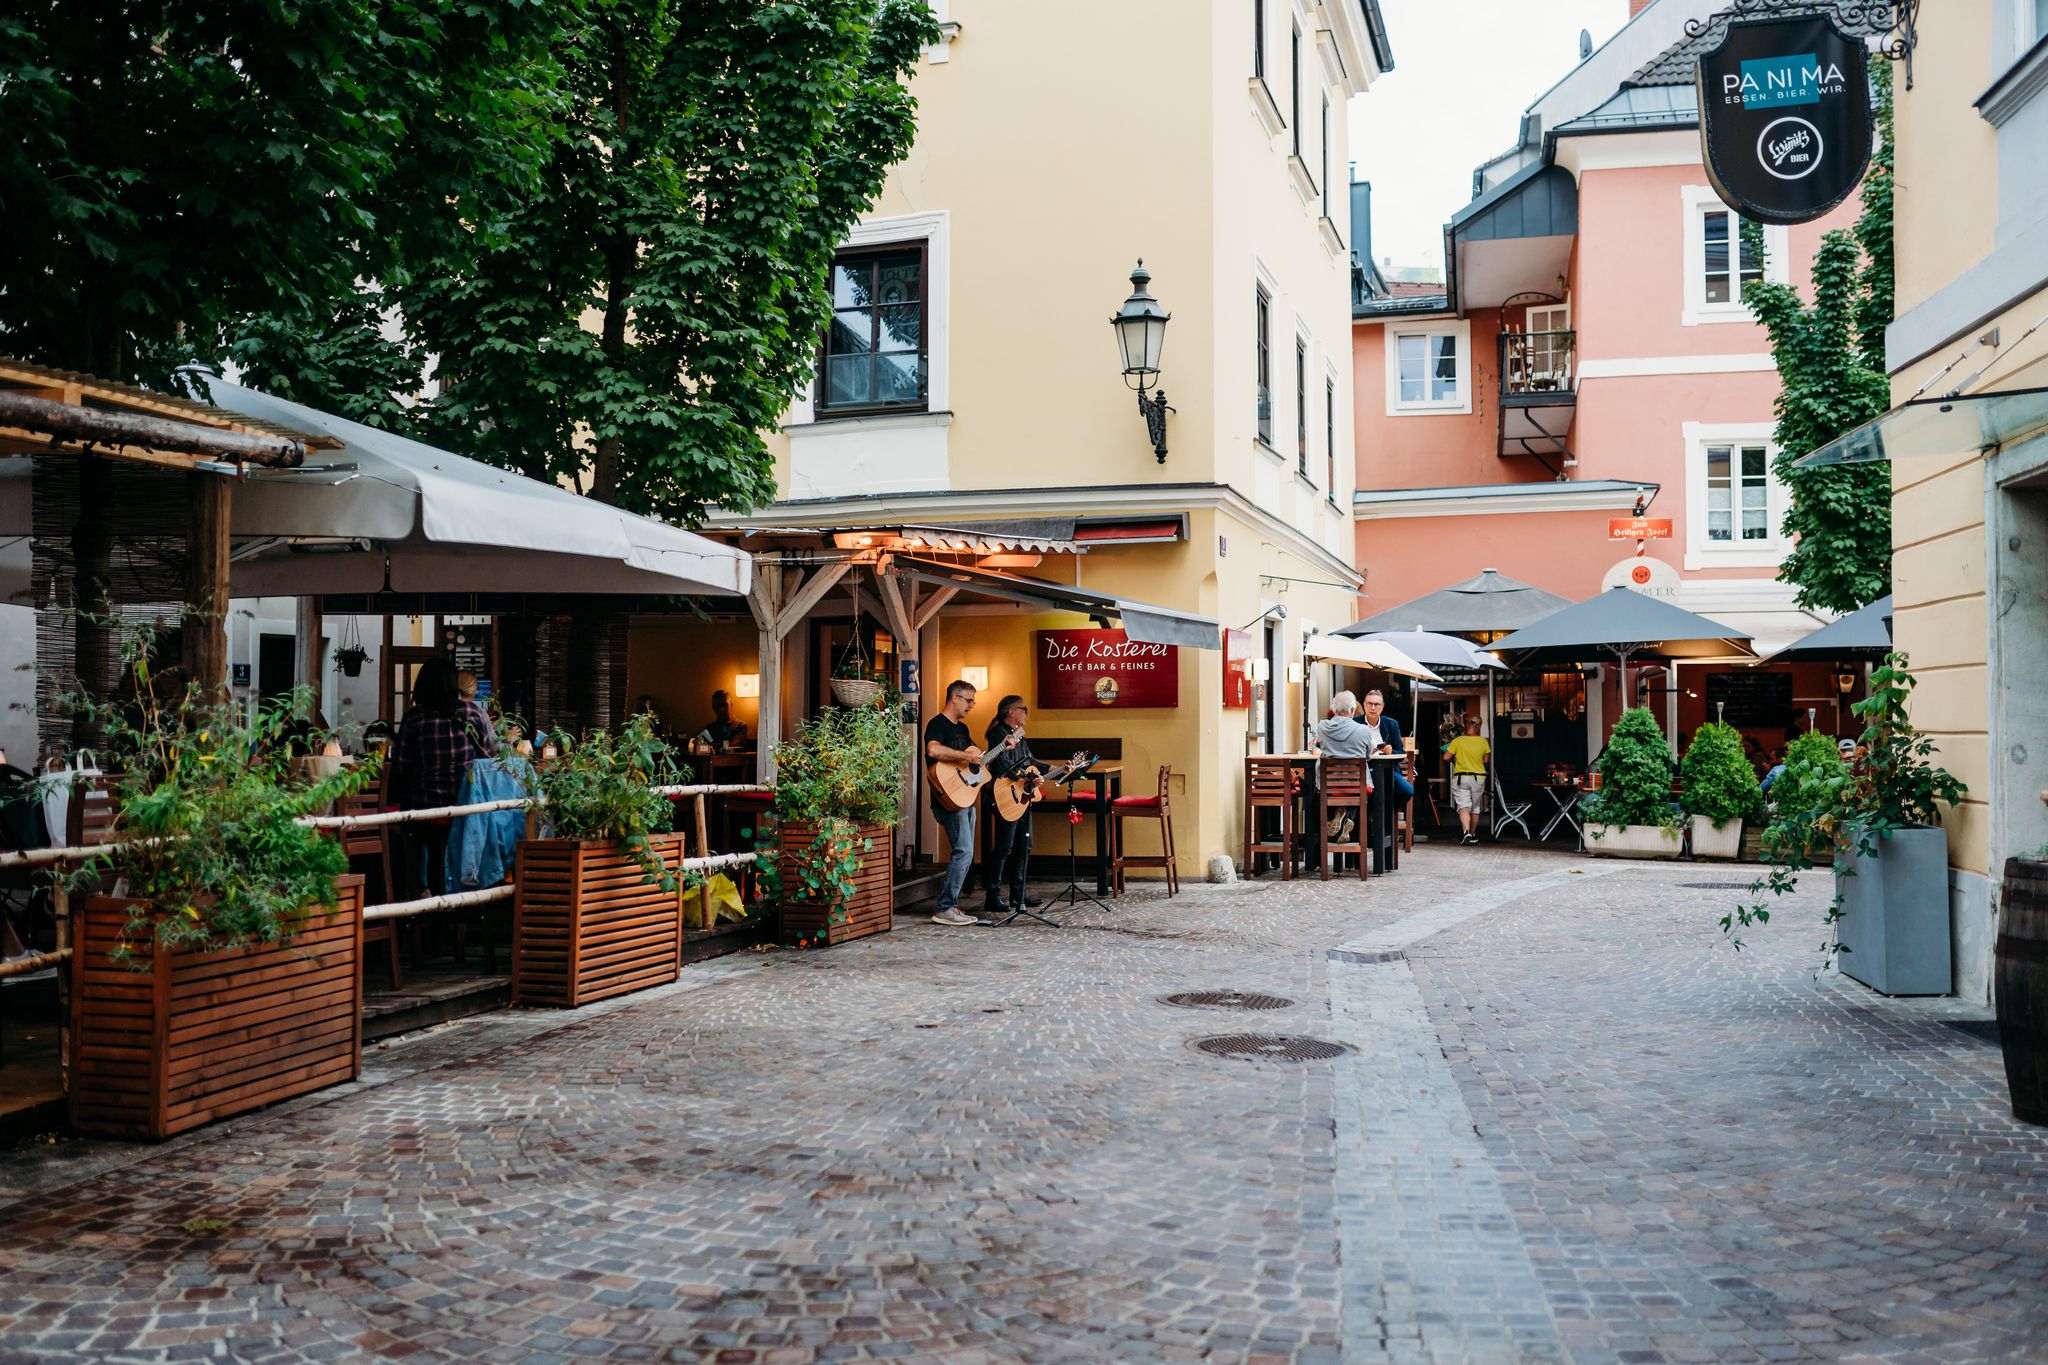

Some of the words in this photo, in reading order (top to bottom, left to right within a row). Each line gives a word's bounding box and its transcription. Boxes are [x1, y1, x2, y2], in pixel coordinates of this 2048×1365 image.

[1723, 73, 1760, 94] PA
[1768, 68, 1792, 90] NI
[1802, 63, 1846, 85] MA
[1777, 89, 1811, 99] BIER.
[1817, 84, 1847, 95] WIR.
[1790, 153, 1810, 163] BIER
[1631, 520, 1648, 529] Zum
[1637, 587, 1676, 596] MER
[1045, 637, 1079, 659] Die
[1086, 637, 1168, 658] Kosterei
[239, 664, 245, 677] 3
[1058, 661, 1083, 671] CAFÉ
[1087, 663, 1106, 671] BAR
[1110, 662, 1117, 670] &
[1120, 662, 1155, 670] FEINES
